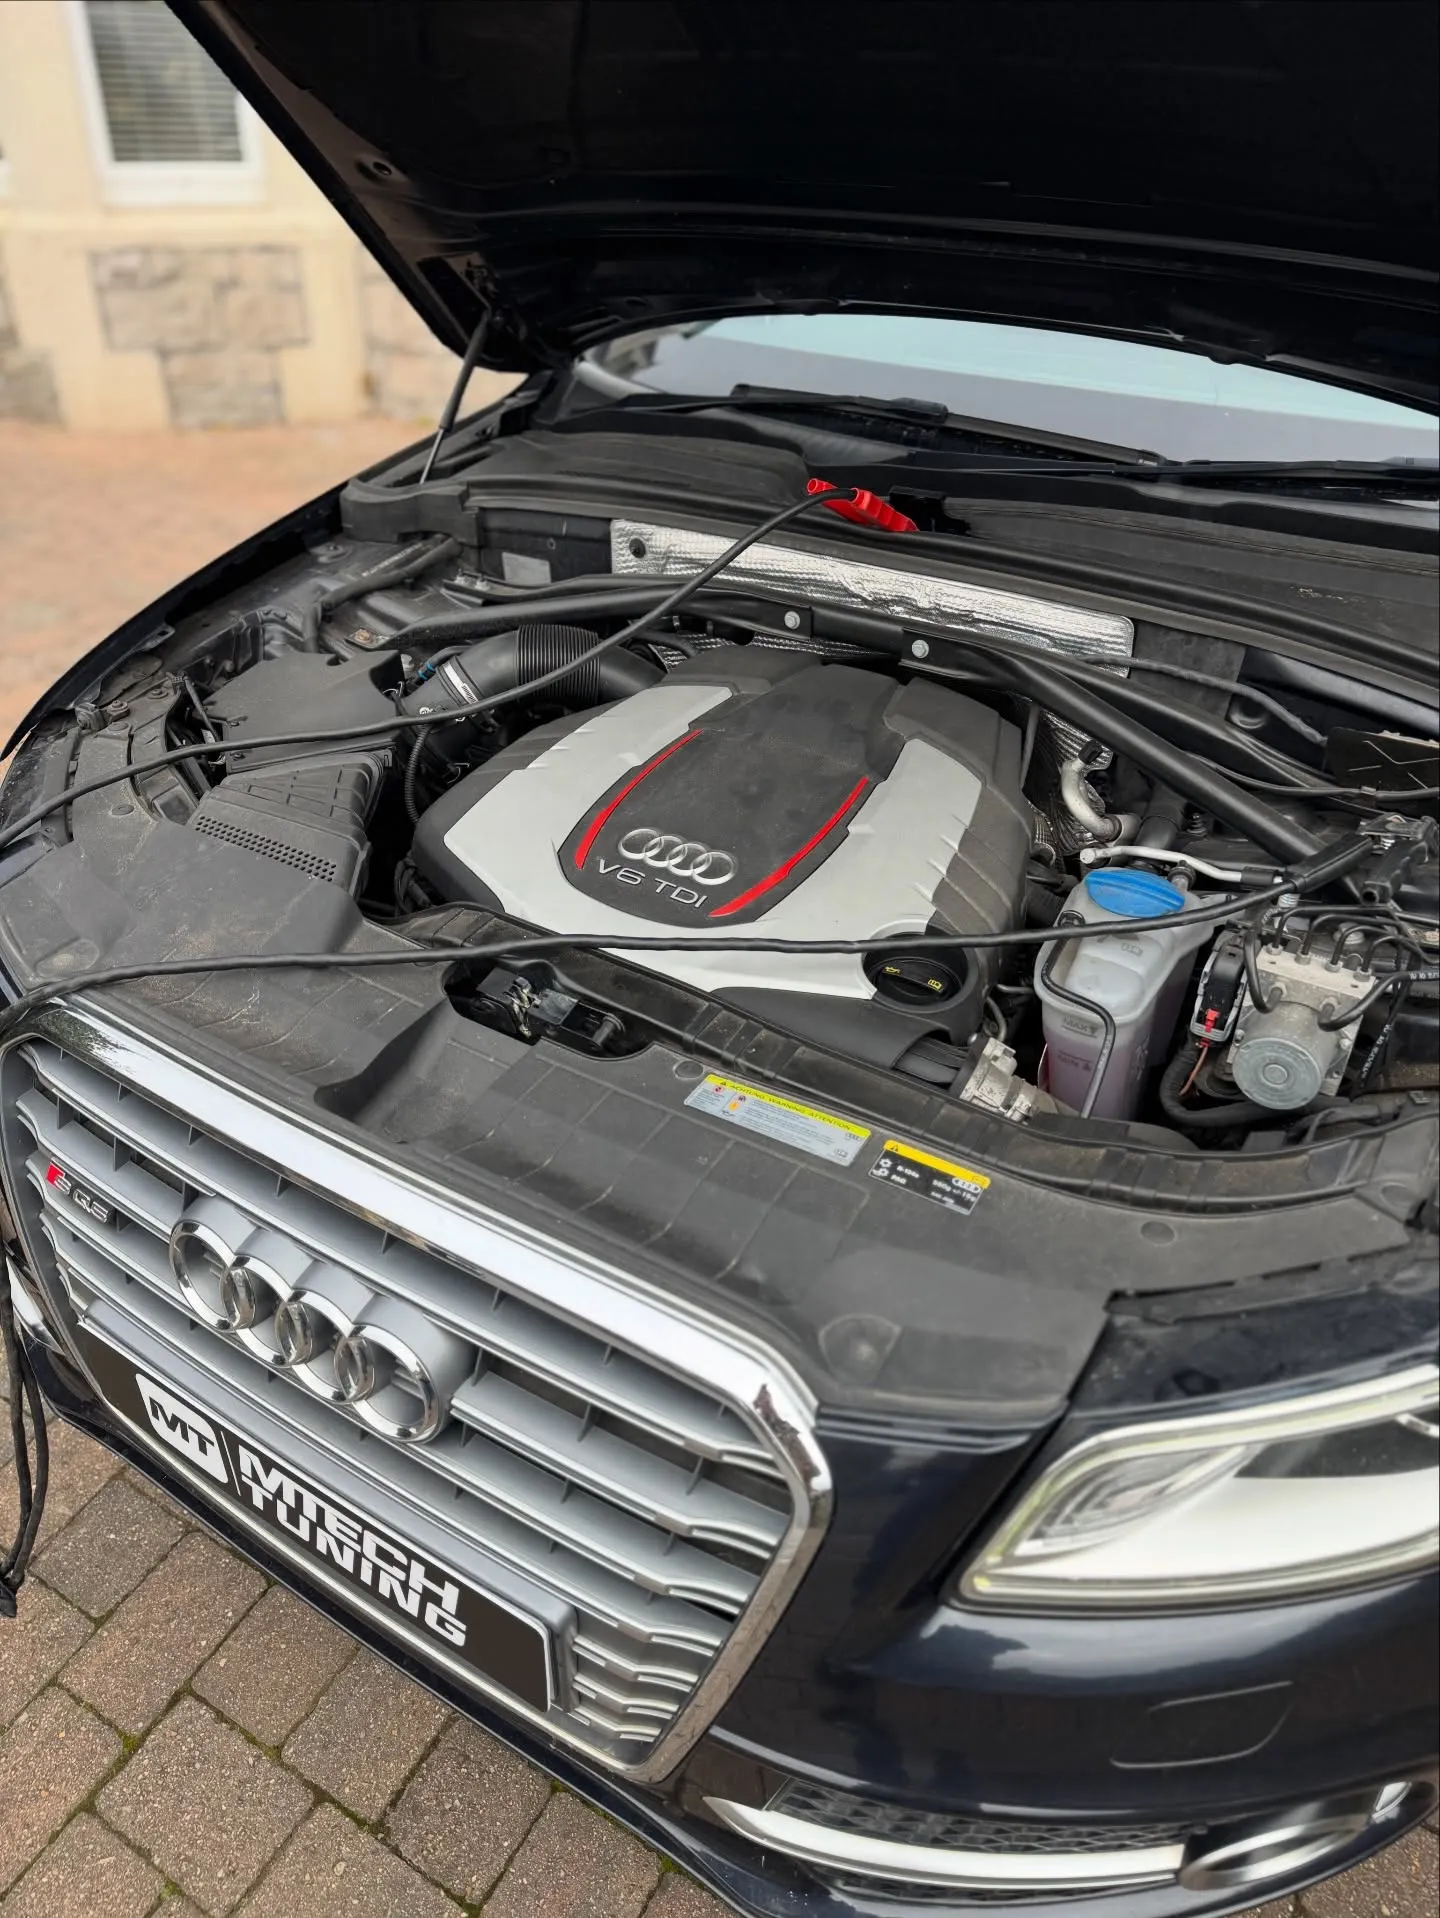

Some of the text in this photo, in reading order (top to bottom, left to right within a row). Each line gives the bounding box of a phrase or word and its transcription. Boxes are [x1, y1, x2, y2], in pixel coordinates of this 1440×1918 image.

[597, 857, 709, 909] V6 TDI
[768, 1097, 806, 1115] WARNING
[808, 1111, 852, 1132] ATTENTION
[238, 1443, 460, 1617] MTECH
[241, 1474, 467, 1648] TUNING
